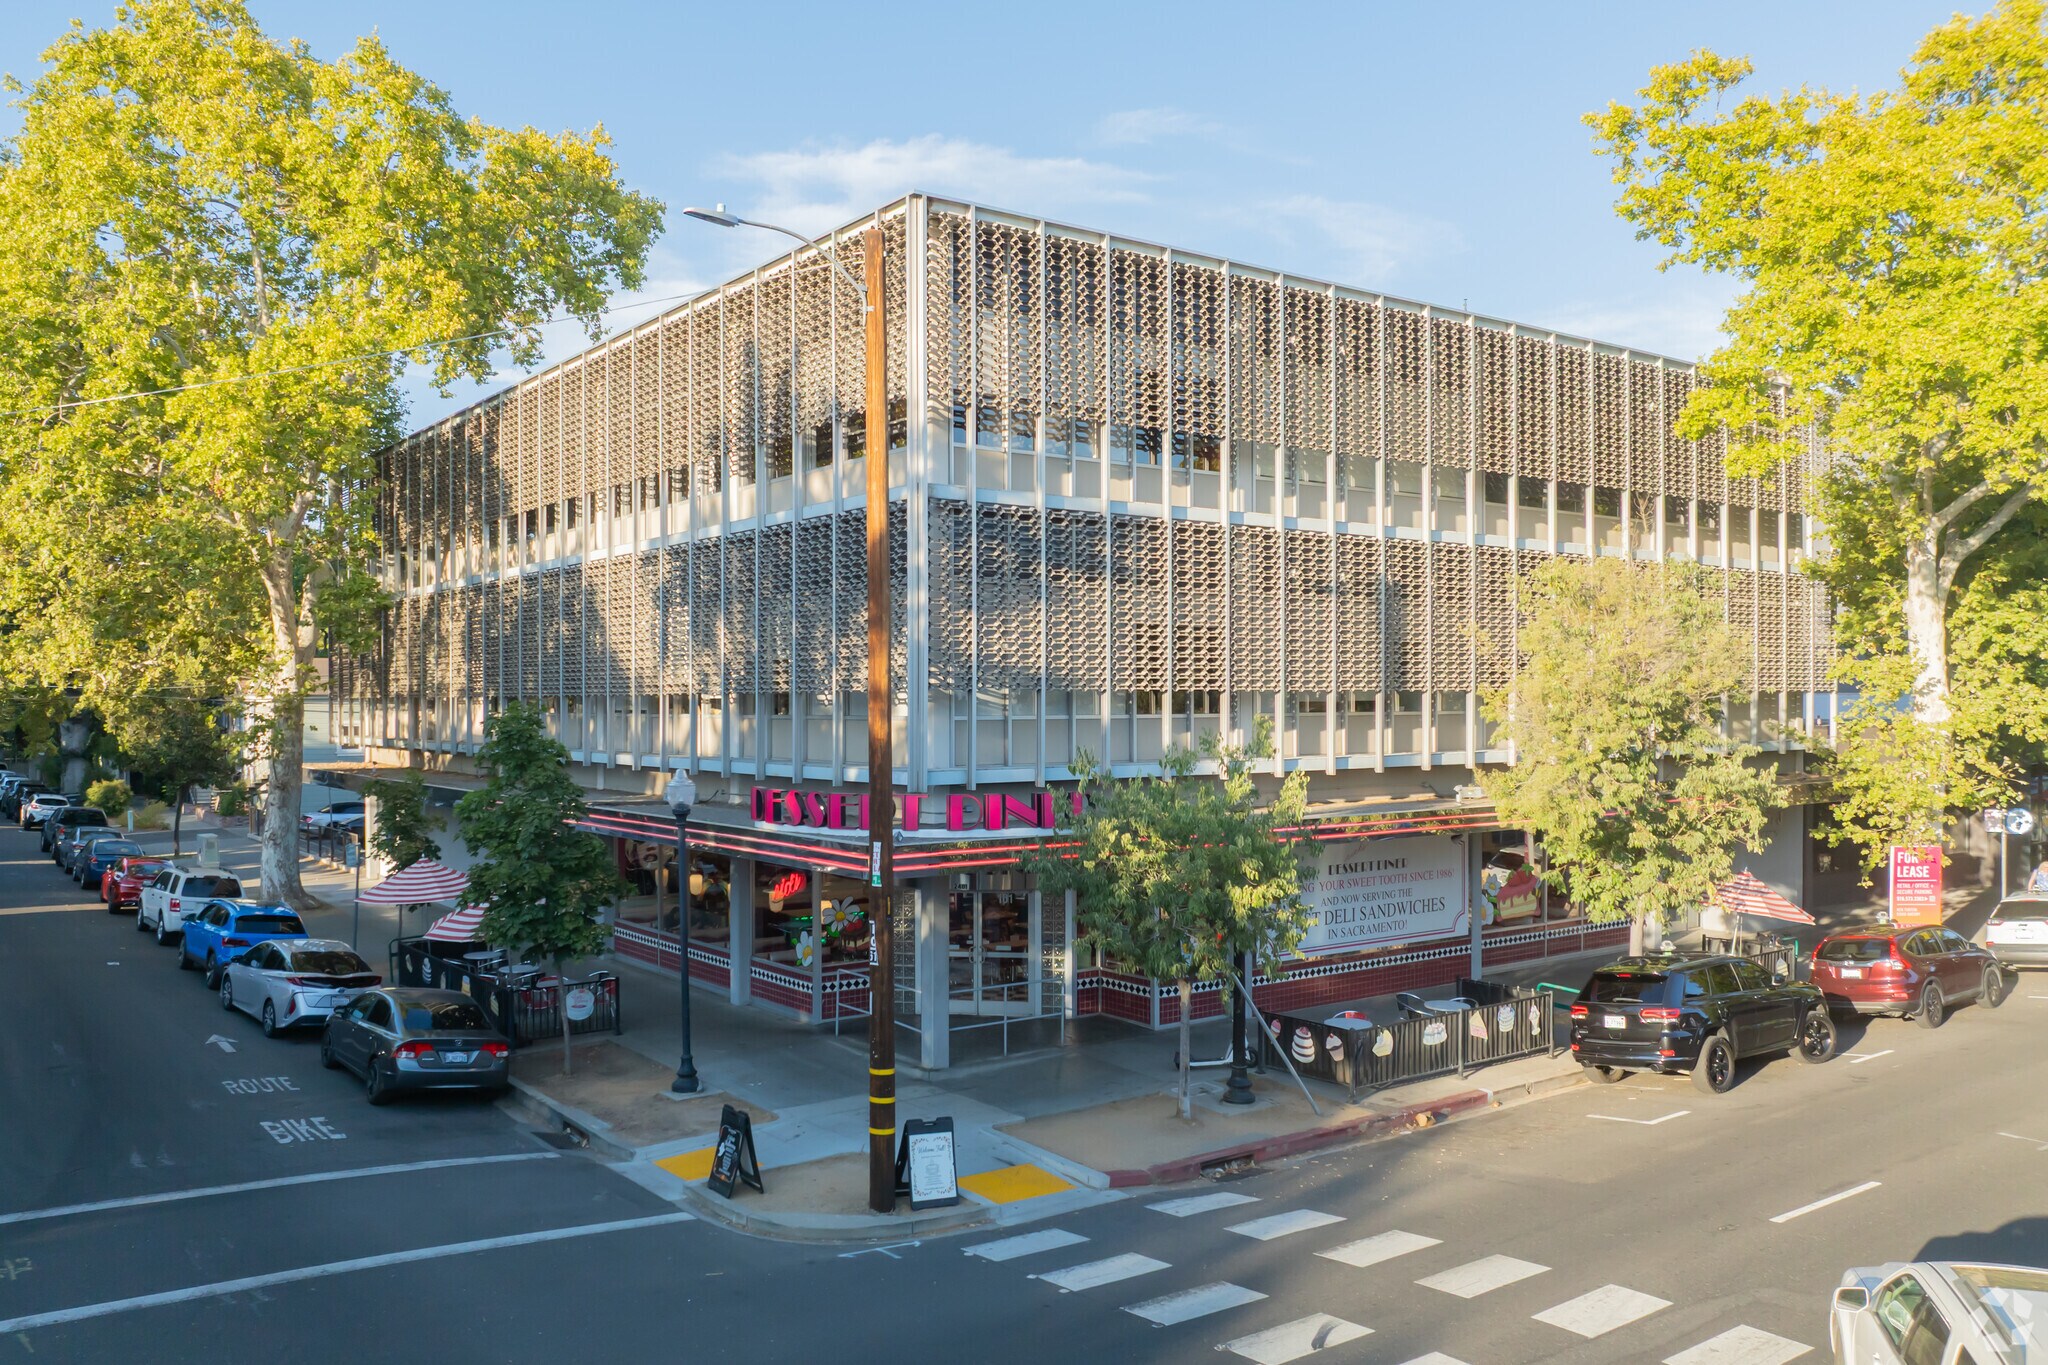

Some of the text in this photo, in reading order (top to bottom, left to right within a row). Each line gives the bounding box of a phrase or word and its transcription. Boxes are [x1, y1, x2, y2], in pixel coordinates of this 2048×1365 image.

[1328, 858, 1408, 876] DESSERT DINER
[1897, 852, 1919, 864] FOR
[1319, 880, 1345, 892] YOUR
[1347, 876, 1376, 888] SWEET
[1378, 873, 1408, 886] TOOTH
[1410, 870, 1434, 882] SINCE
[1436, 868, 1455, 879] 1986!
[1896, 866, 1930, 878] LEASE
[1321, 888, 1413, 907] AND NOW SERVING THE
[1324, 907, 1356, 926] DELI
[1359, 896, 1446, 921] SANDWICHES
[1328, 919, 1408, 940] IN SACRAMENTO!
[221, 1077, 300, 1094] ROUTE
[259, 1116, 347, 1144] BIKE
